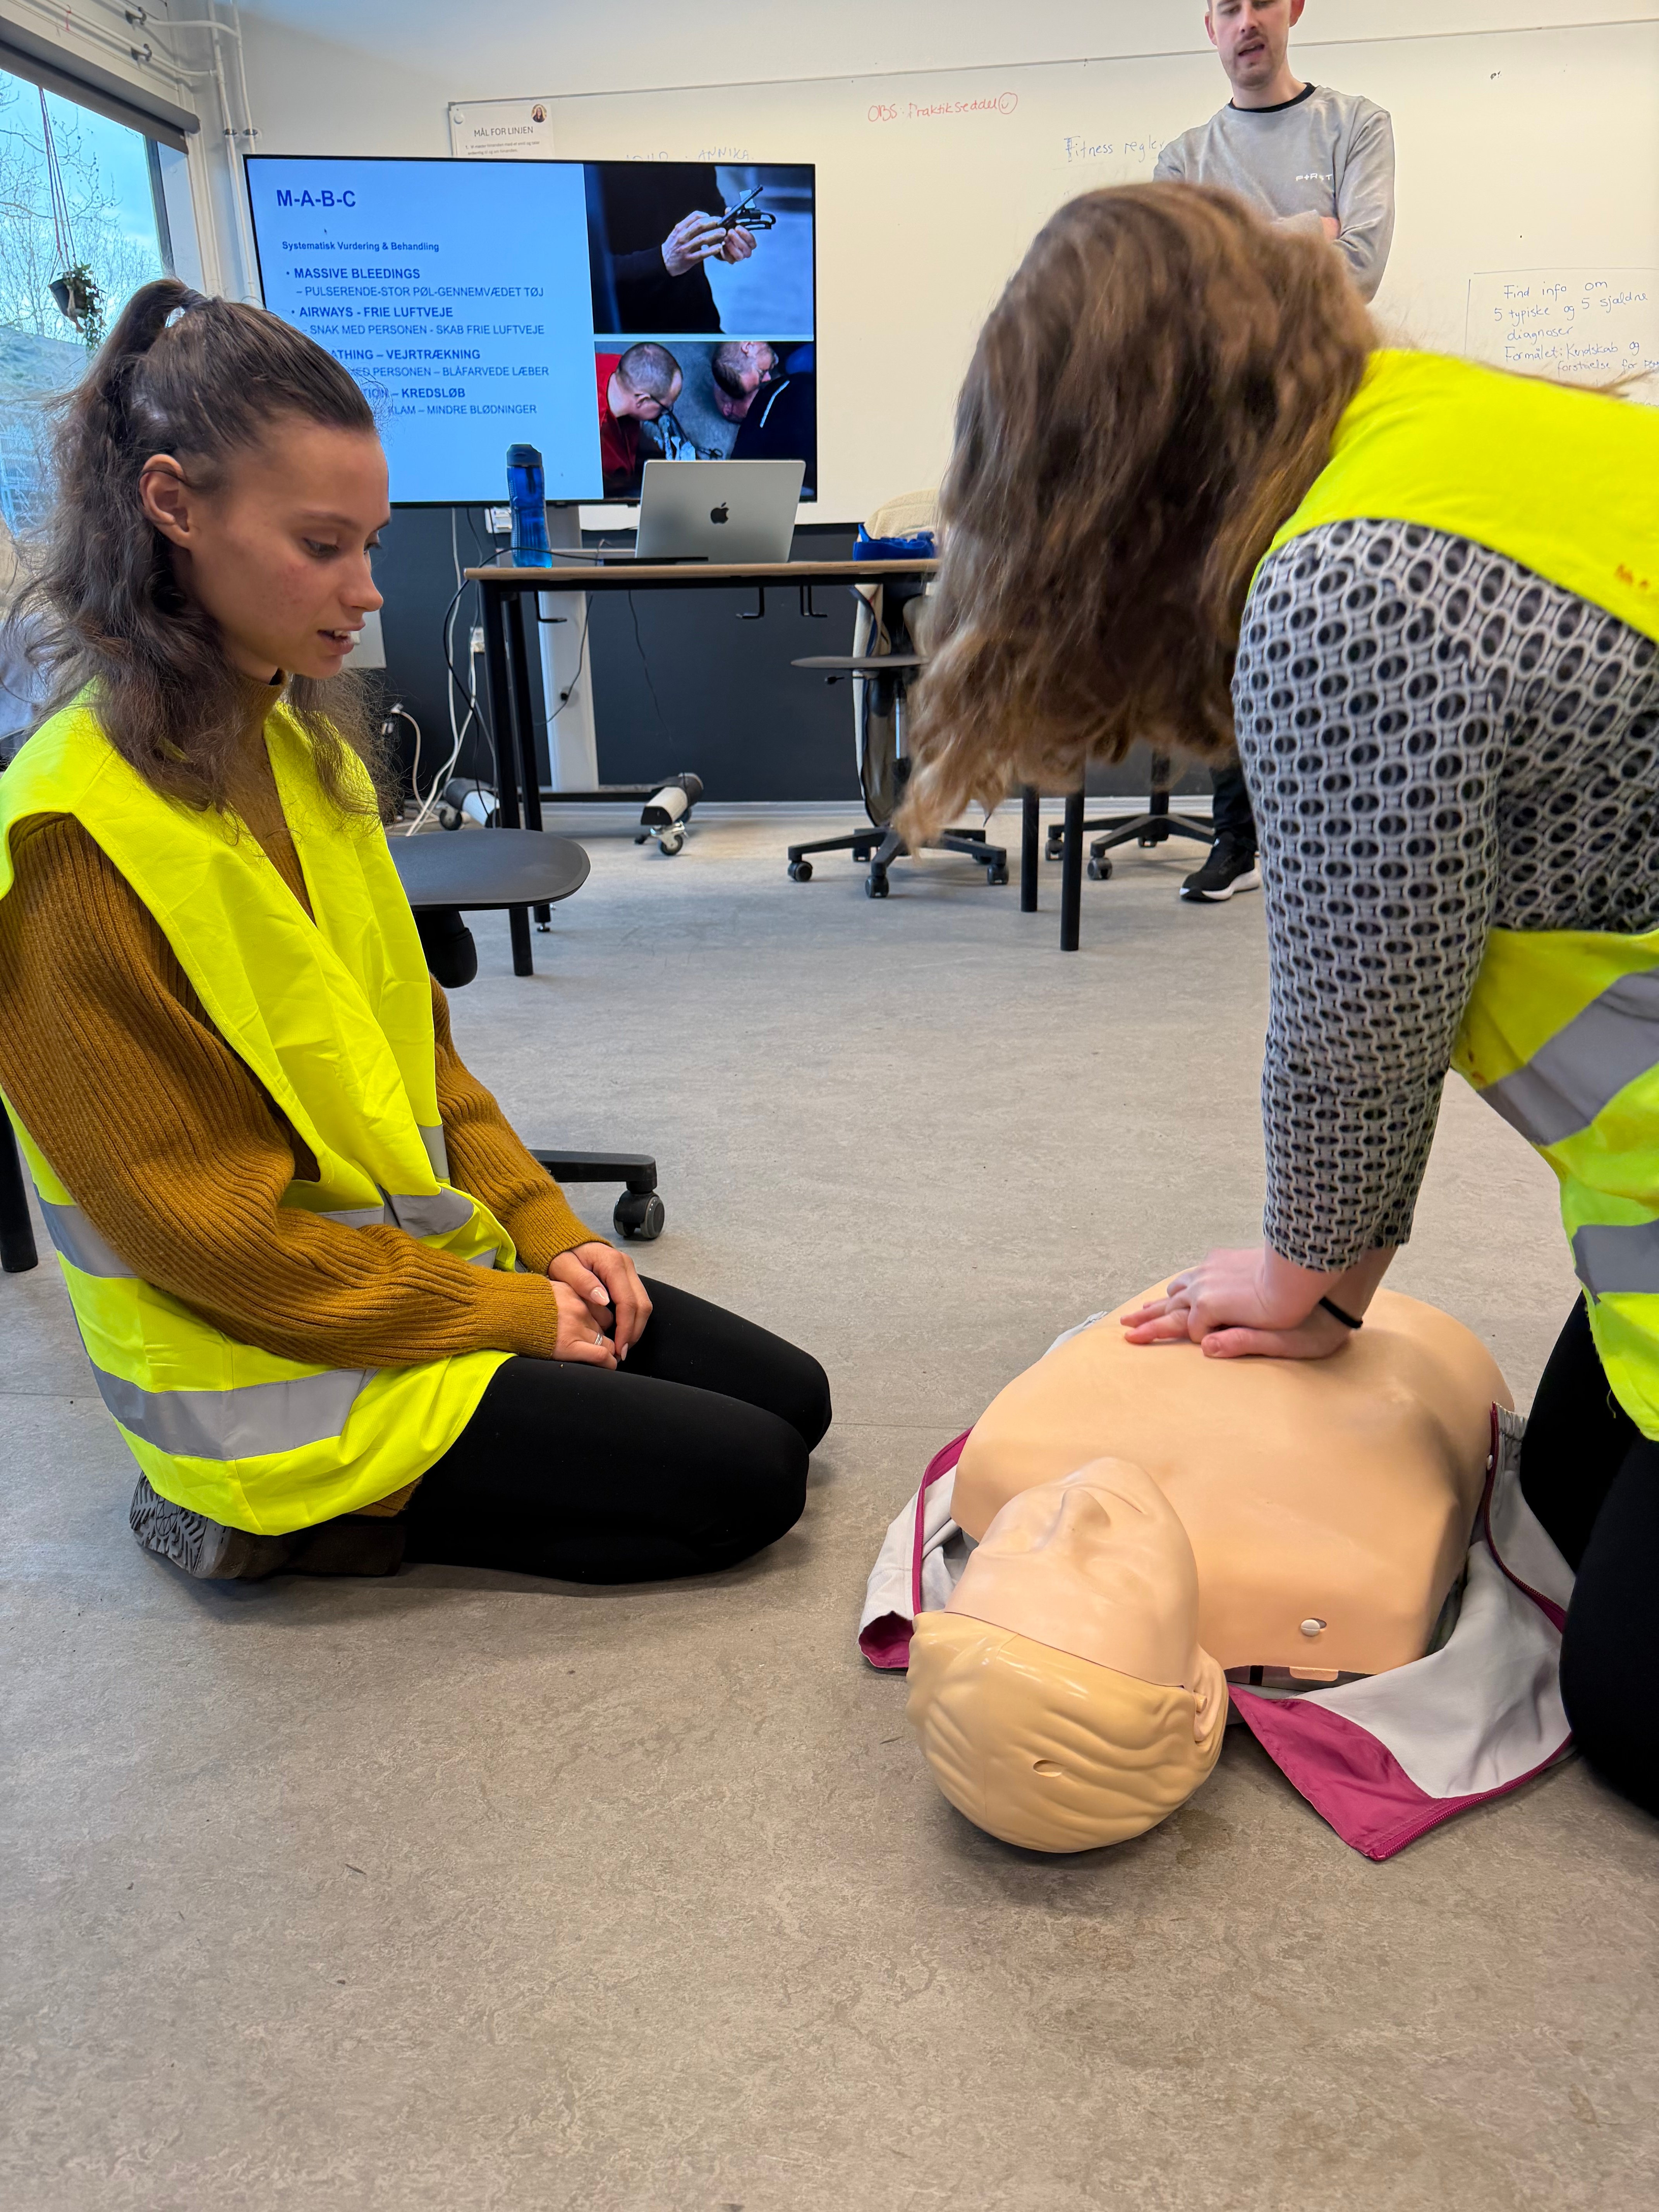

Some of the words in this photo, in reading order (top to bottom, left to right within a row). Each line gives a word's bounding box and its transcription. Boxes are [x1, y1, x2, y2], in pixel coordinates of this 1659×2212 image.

[474, 127, 489, 137] MÅL
[508, 126, 533, 135] LINJEN
[1064, 136, 1113, 162] Fitness
[276, 189, 356, 207] M-A-B-C
[282, 241, 335, 251] Systematisk
[337, 241, 380, 252] Vurdering
[382, 242, 388, 250] &
[391, 242, 439, 252] Behandling
[294, 268, 348, 278] MASSIVE
[351, 268, 420, 279] BLEEDINGS
[305, 286, 410, 297] PULSERENDE-STOR
[413, 287, 522, 297] PØL-GENNEMVÆDET
[524, 287, 543, 297] TØJ
[1504, 285, 1530, 299] Find
[1542, 282, 1567, 301] info
[1585, 281, 1607, 291] om
[299, 307, 353, 317] AIRWAYS
[364, 307, 391, 317] FRIE
[394, 307, 453, 317] LUFTVEJE
[1494, 308, 1502, 321] 5
[1508, 304, 1550, 327] typiske
[1564, 305, 1575, 321] og
[1582, 298, 1590, 309] 5
[310, 325, 340, 335] SNAK
[342, 325, 366, 335] MED
[368, 325, 427, 335] PERSONEN
[436, 325, 464, 335] SKAB
[467, 325, 491, 335] FRIE
[493, 325, 544, 335] LUFTVEJE
[332, 350, 373, 360] ATHING
[386, 349, 480, 360] VEJRTRÆKNING
[1630, 342, 1640, 356] og
[373, 367, 432, 376] PERSONEN
[442, 365, 510, 376] BLÅFARVEDE
[512, 366, 549, 376] LÆBER
[401, 388, 465, 398] KREDSLØB
[427, 405, 467, 414] MINDRE
[469, 404, 537, 414] BLØDNINGER
